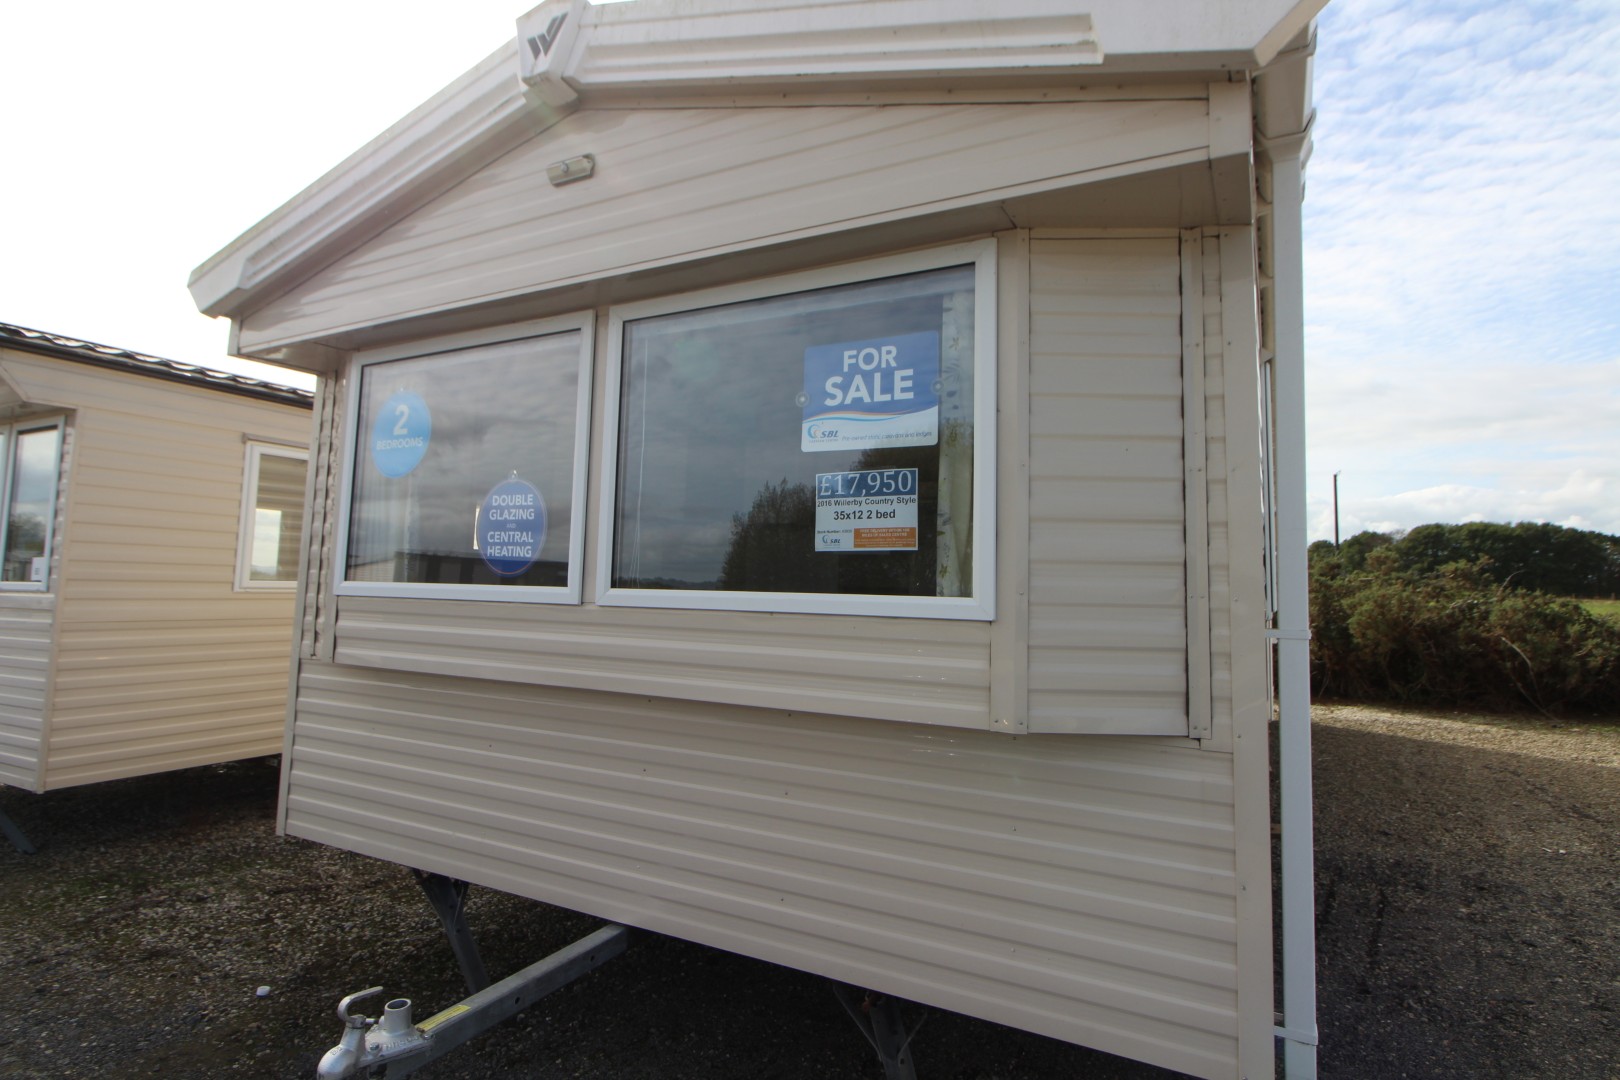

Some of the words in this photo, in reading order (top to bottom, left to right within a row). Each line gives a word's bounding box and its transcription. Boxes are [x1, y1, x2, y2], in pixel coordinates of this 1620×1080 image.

[843, 345, 897, 372] FOR
[824, 368, 914, 407] SALE
[393, 404, 409, 435] 2
[820, 430, 839, 439] SBL
[376, 437, 423, 450] BEDROOMS
[820, 470, 912, 496] £17,950
[492, 494, 534, 506] DOUBLE
[833, 498, 863, 507] Willerby
[864, 497, 894, 506] Country
[896, 496, 916, 505] Style
[489, 508, 535, 520] GLAZING
[833, 510, 863, 520] 35x12
[866, 509, 873, 519] 2
[875, 508, 896, 519] bed
[487, 531, 534, 543] CENTRAL
[487, 545, 532, 557] HEATING
